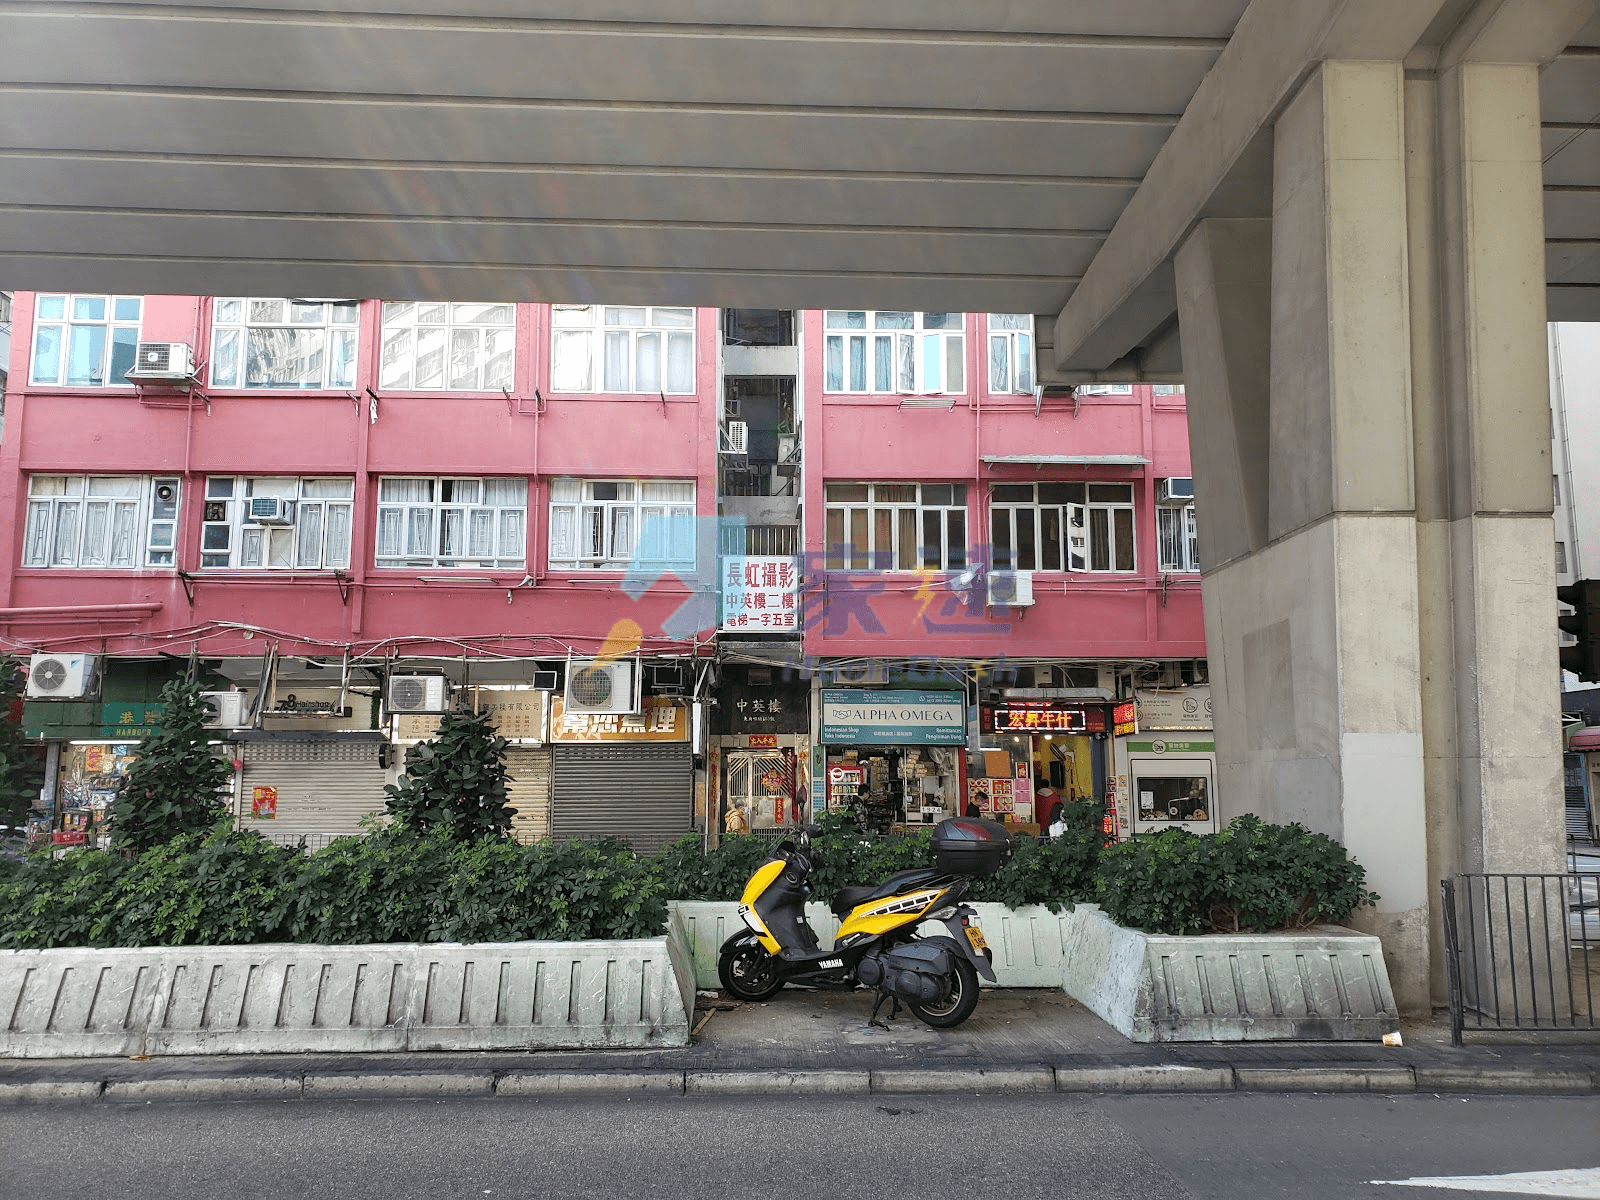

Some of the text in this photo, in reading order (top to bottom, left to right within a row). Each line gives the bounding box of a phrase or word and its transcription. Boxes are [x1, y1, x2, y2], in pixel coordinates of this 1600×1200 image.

[726, 561, 794, 589] 長虹攝影
[726, 592, 795, 610] 中英樓二樓
[726, 612, 795, 627] 電梯一字五室
[736, 698, 783, 714] 中英樓
[852, 709, 953, 722] ALPHA OMEGA
[1008, 711, 1073, 728] 宏昇牛什
[817, 958, 844, 970] YAMAHA
